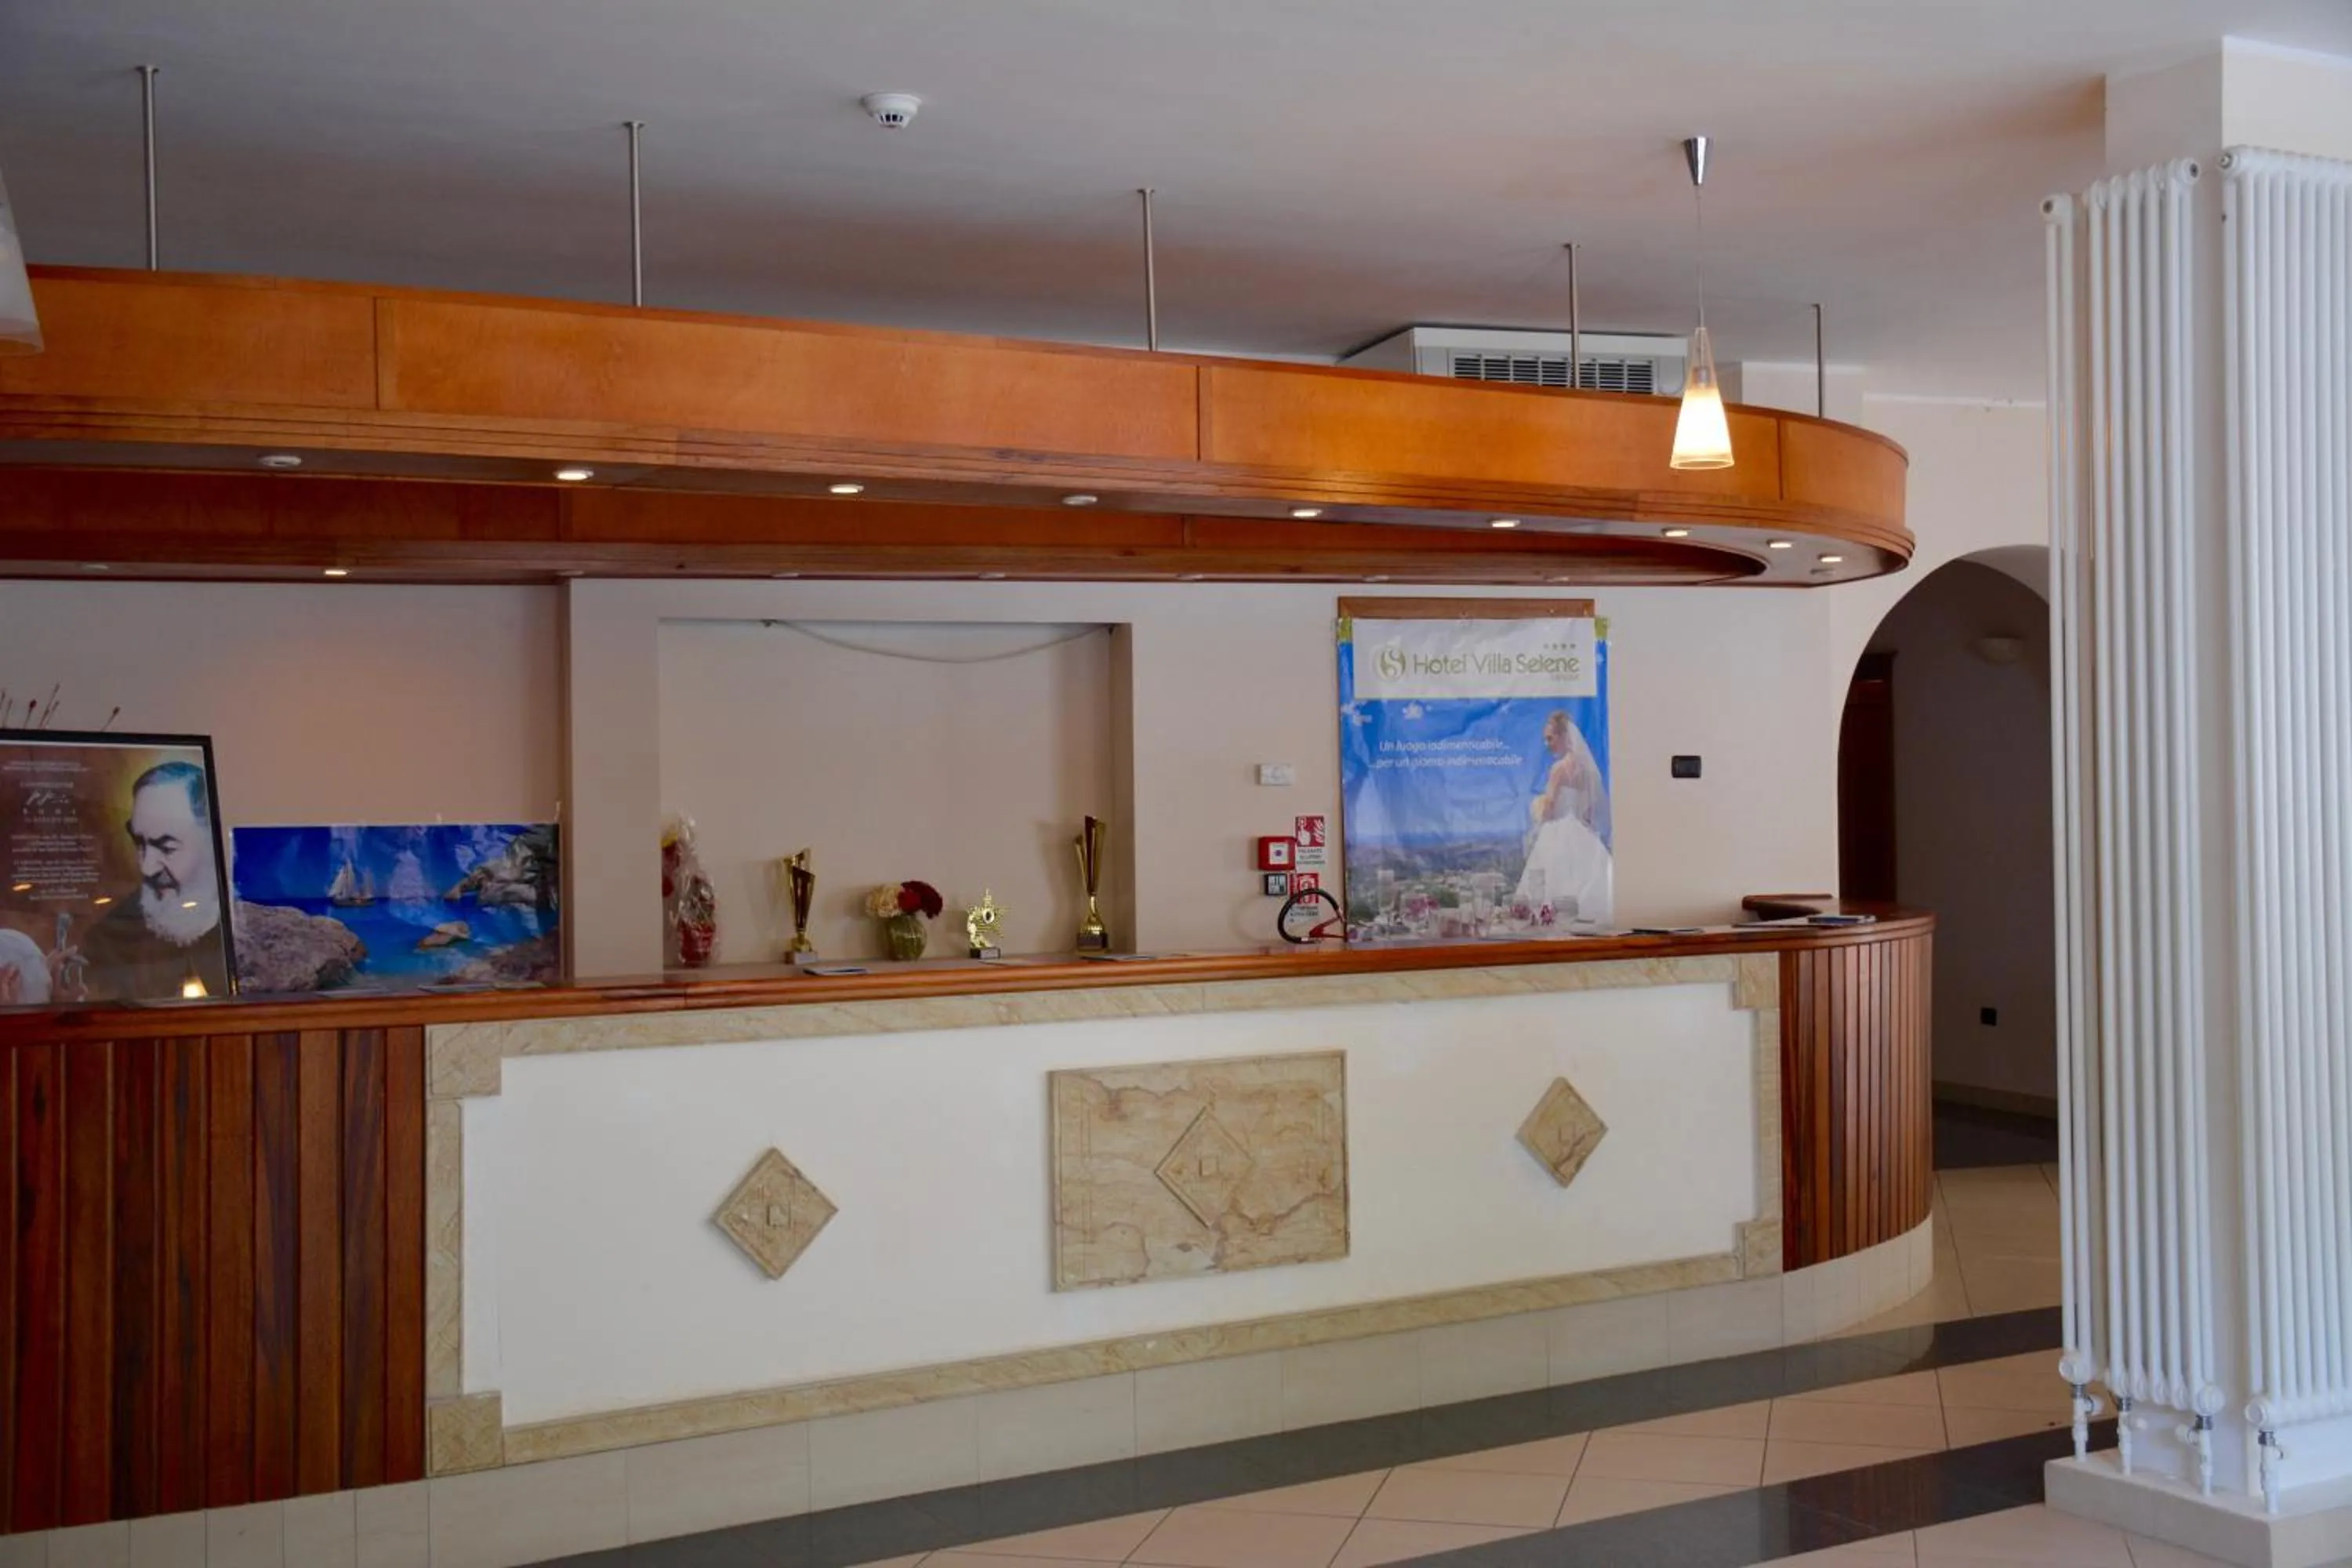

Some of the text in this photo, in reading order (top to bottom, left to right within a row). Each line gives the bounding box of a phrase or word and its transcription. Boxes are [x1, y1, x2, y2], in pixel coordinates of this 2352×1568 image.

[1413, 652, 1467, 675] Hotel
[1471, 652, 1512, 675] Villa
[1515, 652, 1581, 674] Selene
